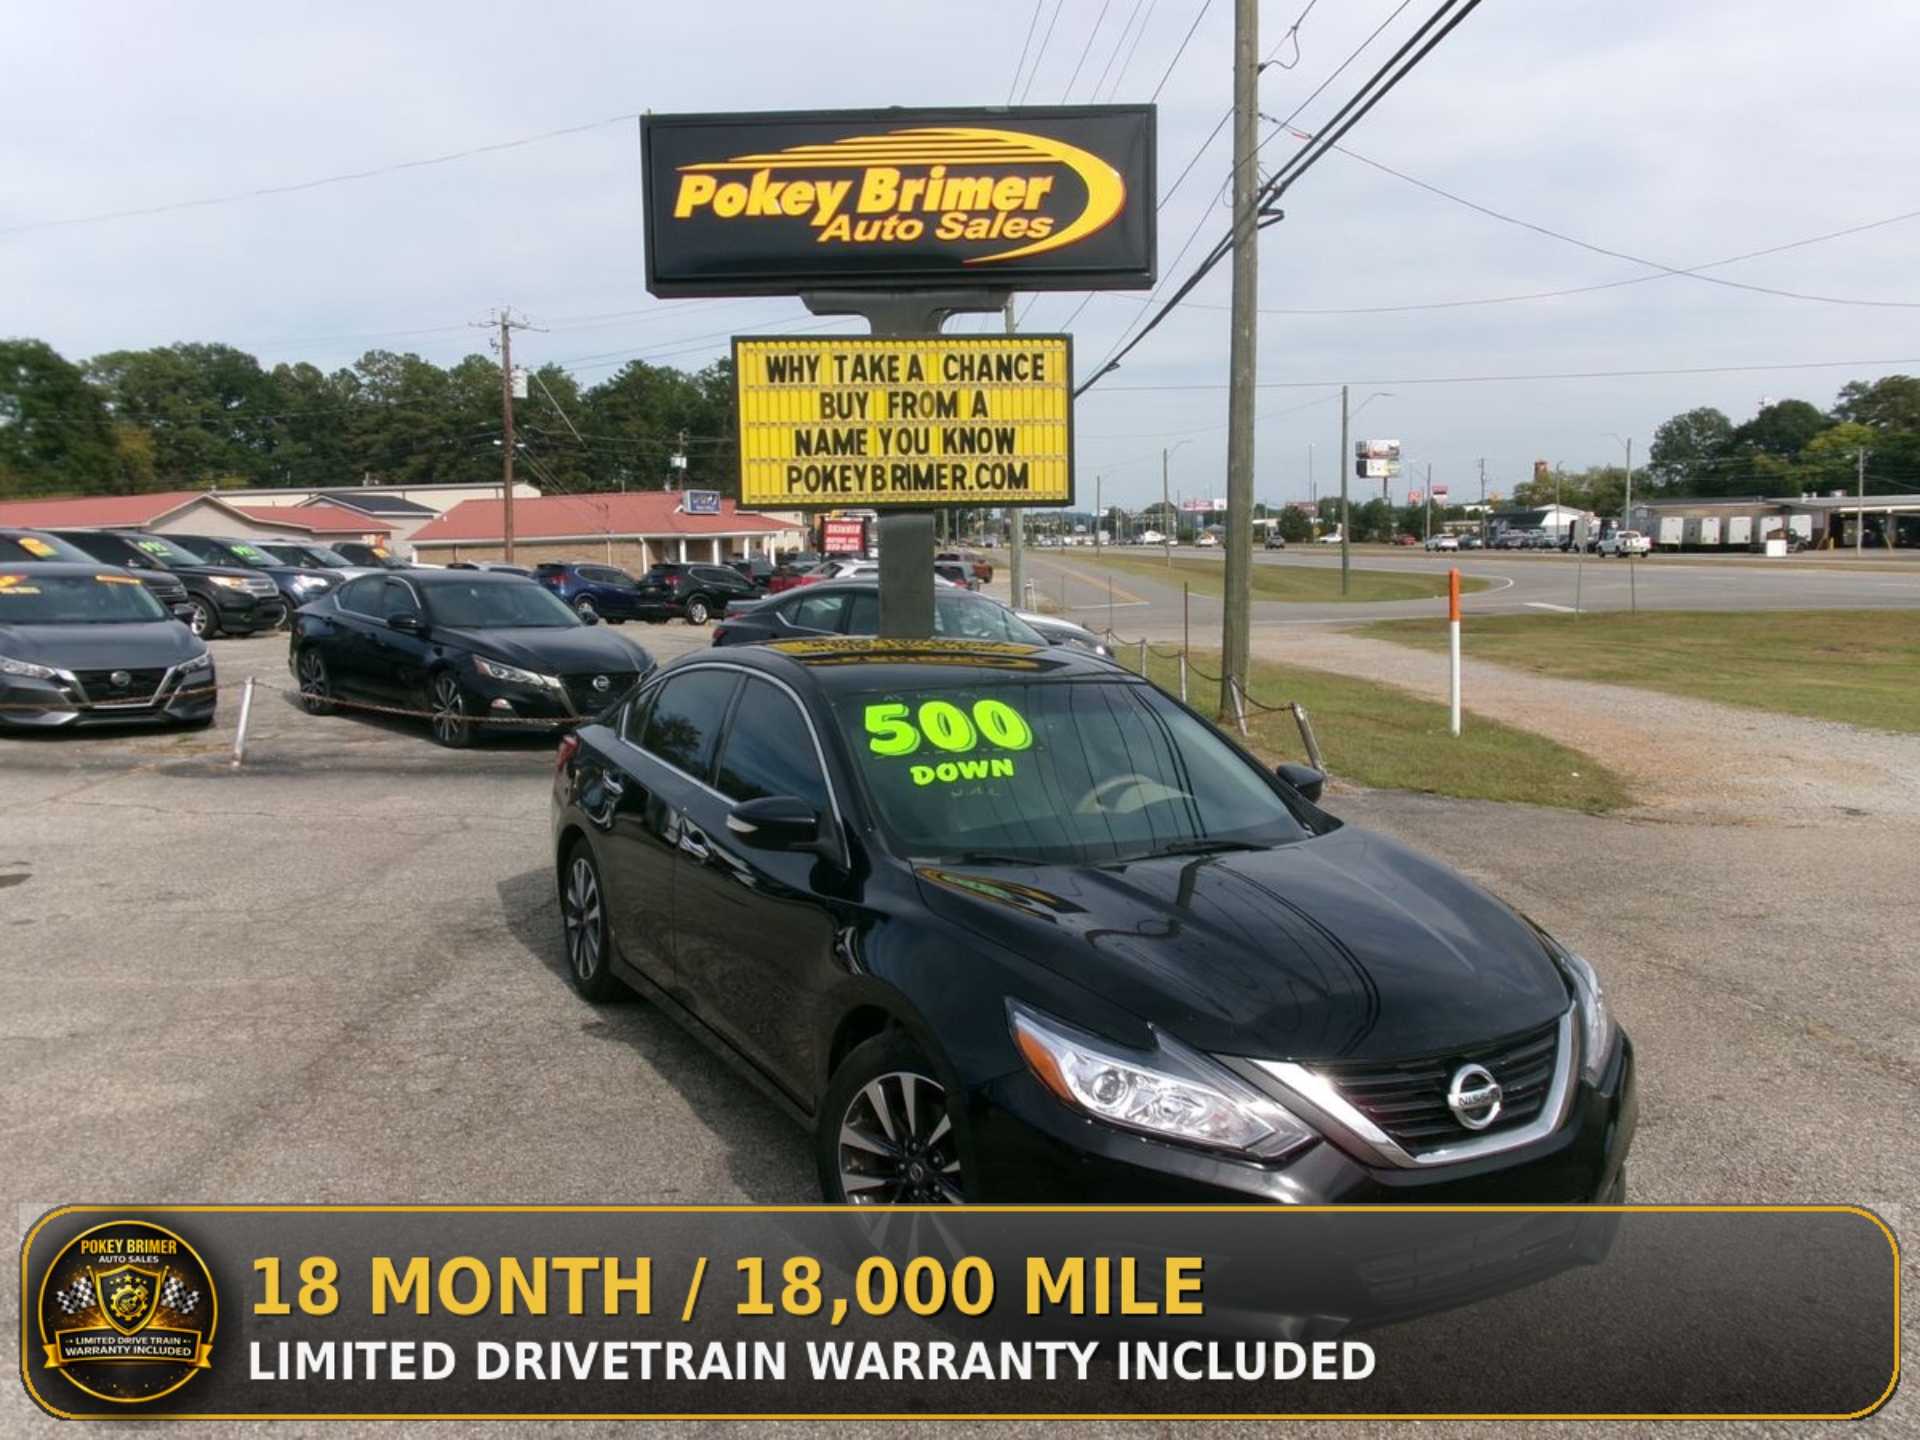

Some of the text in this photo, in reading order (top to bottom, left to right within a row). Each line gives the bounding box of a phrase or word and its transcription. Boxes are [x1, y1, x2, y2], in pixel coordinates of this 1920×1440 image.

[674, 165, 1053, 227] Pokey Brimer
[818, 211, 1054, 242] Auto Sales
[765, 353, 1045, 383] WHY TAKE A CHANCE
[819, 390, 989, 420] BUY FROM A
[794, 427, 1015, 456] NAME YOU KNOW
[786, 462, 1029, 493] POKEYBRIMER.COM
[864, 699, 1033, 756] 500
[909, 758, 1015, 785] DOWN
